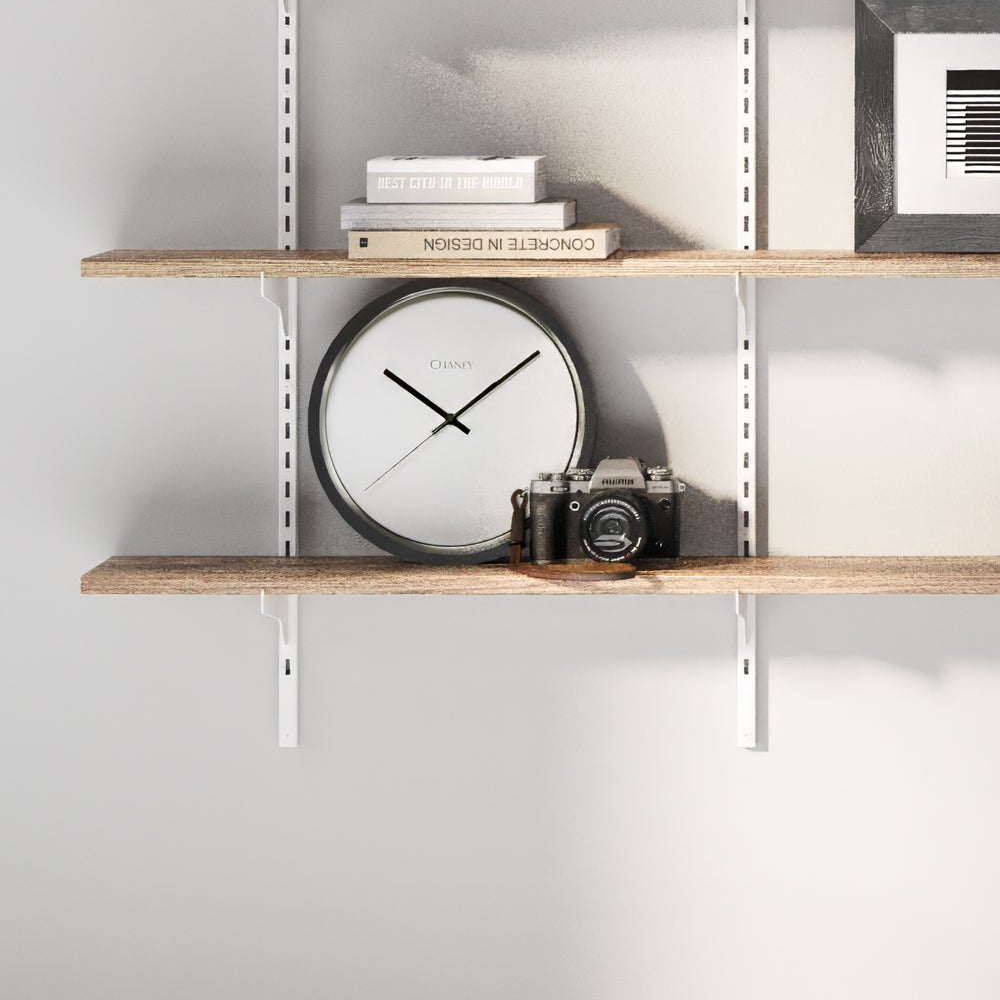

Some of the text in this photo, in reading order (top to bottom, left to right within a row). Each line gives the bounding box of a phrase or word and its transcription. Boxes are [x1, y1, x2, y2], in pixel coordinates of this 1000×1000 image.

[423, 237, 596, 251] CONCRETE IN DESIGN
